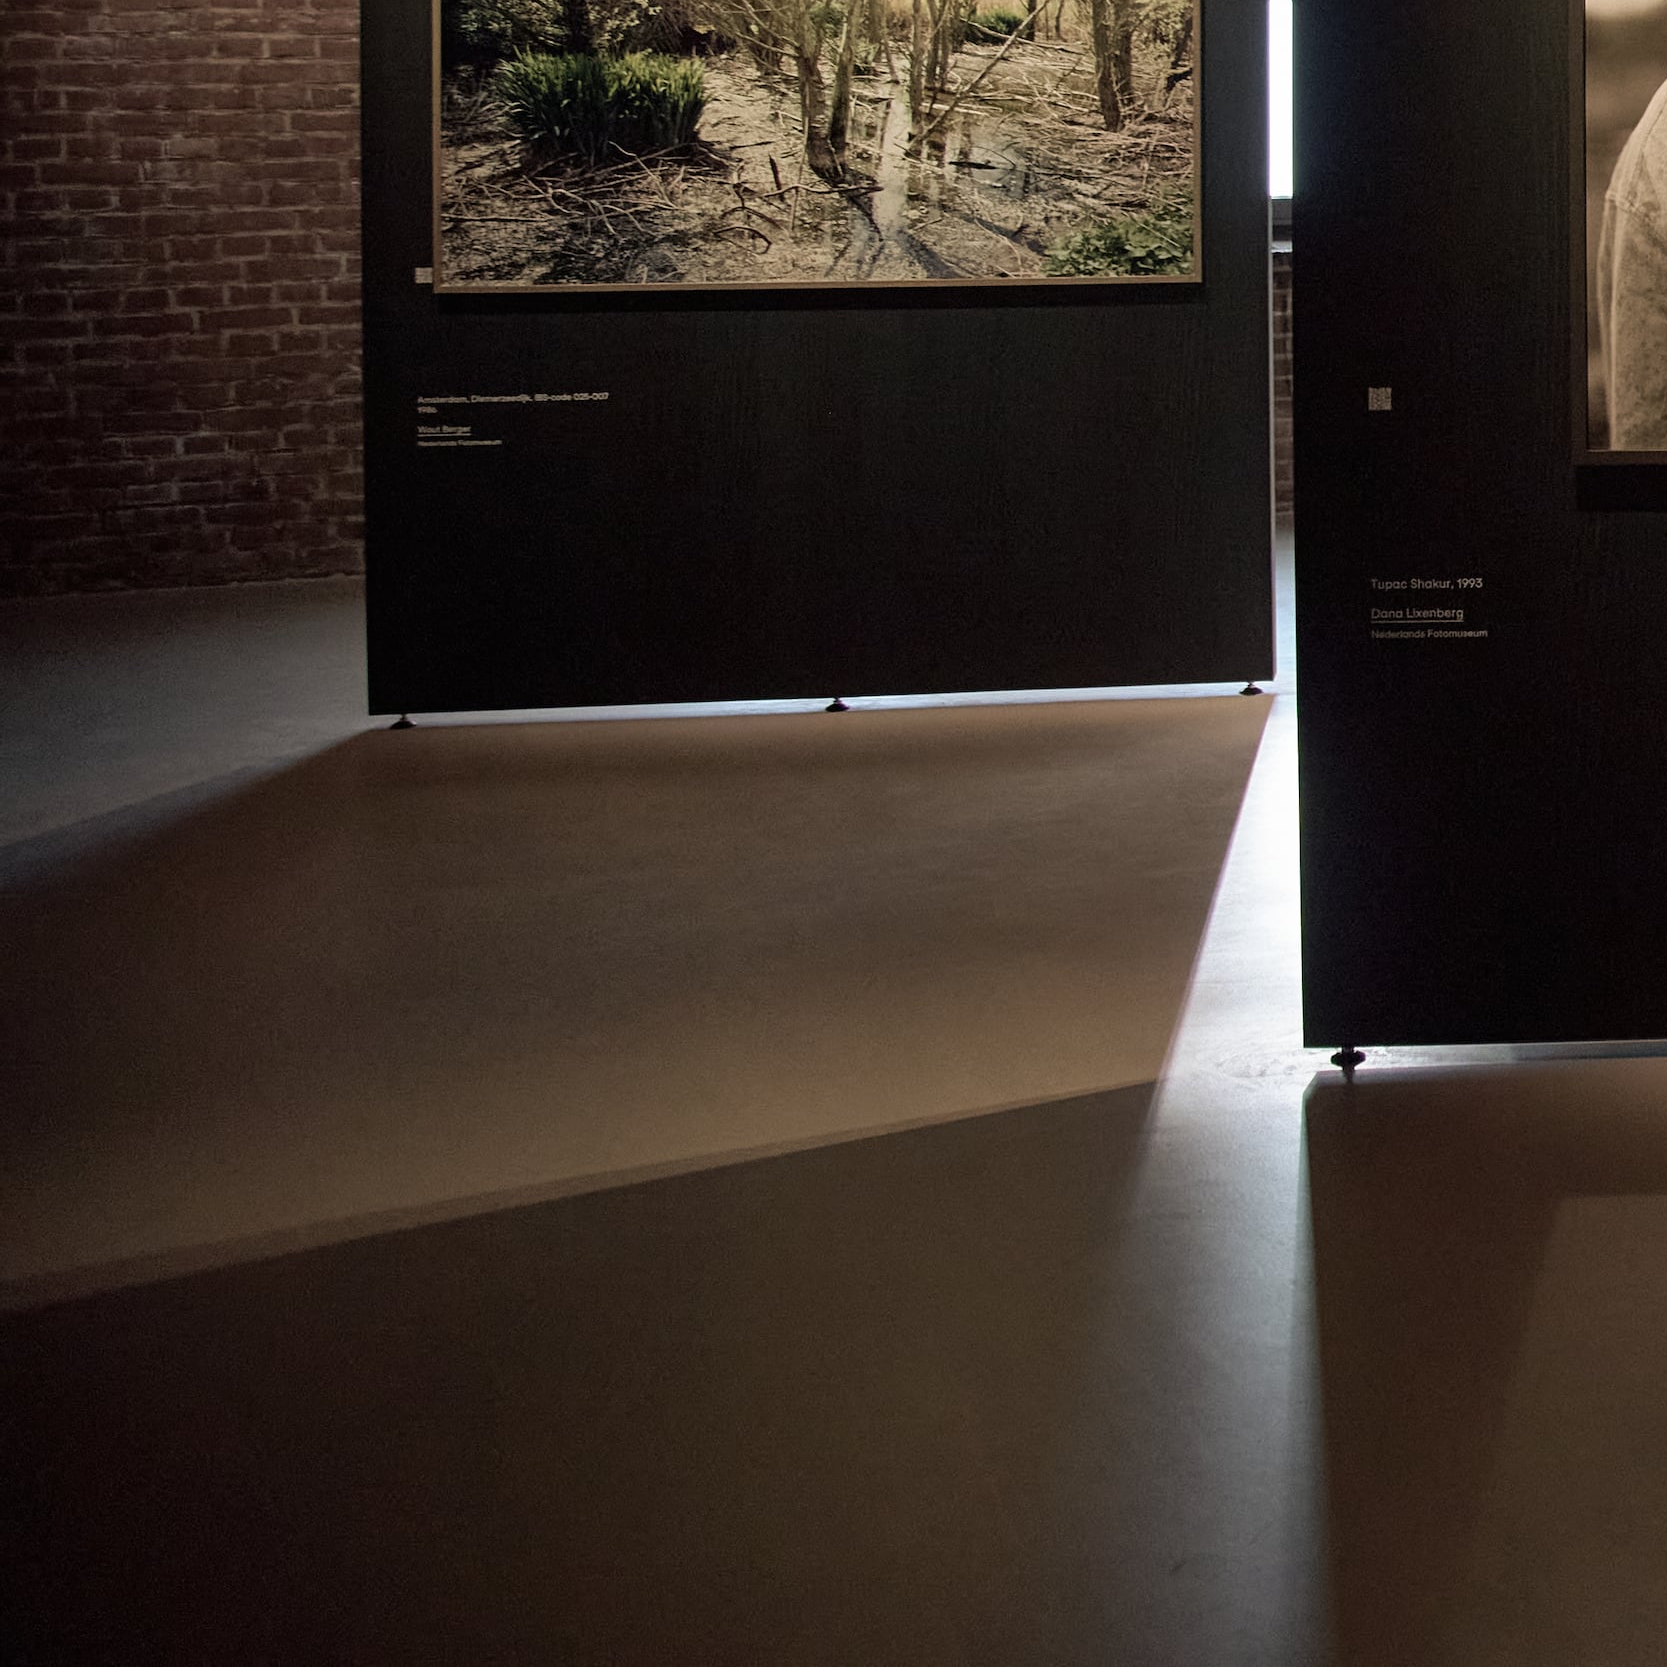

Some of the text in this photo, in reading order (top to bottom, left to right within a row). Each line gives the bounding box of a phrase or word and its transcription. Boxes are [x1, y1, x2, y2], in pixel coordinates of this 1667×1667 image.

[1371, 577, 1483, 591] Tupac Shakur, 1993
[1371, 607, 1464, 621] Dana Lixenberg
[1427, 628, 1488, 638] Fotomuseum
